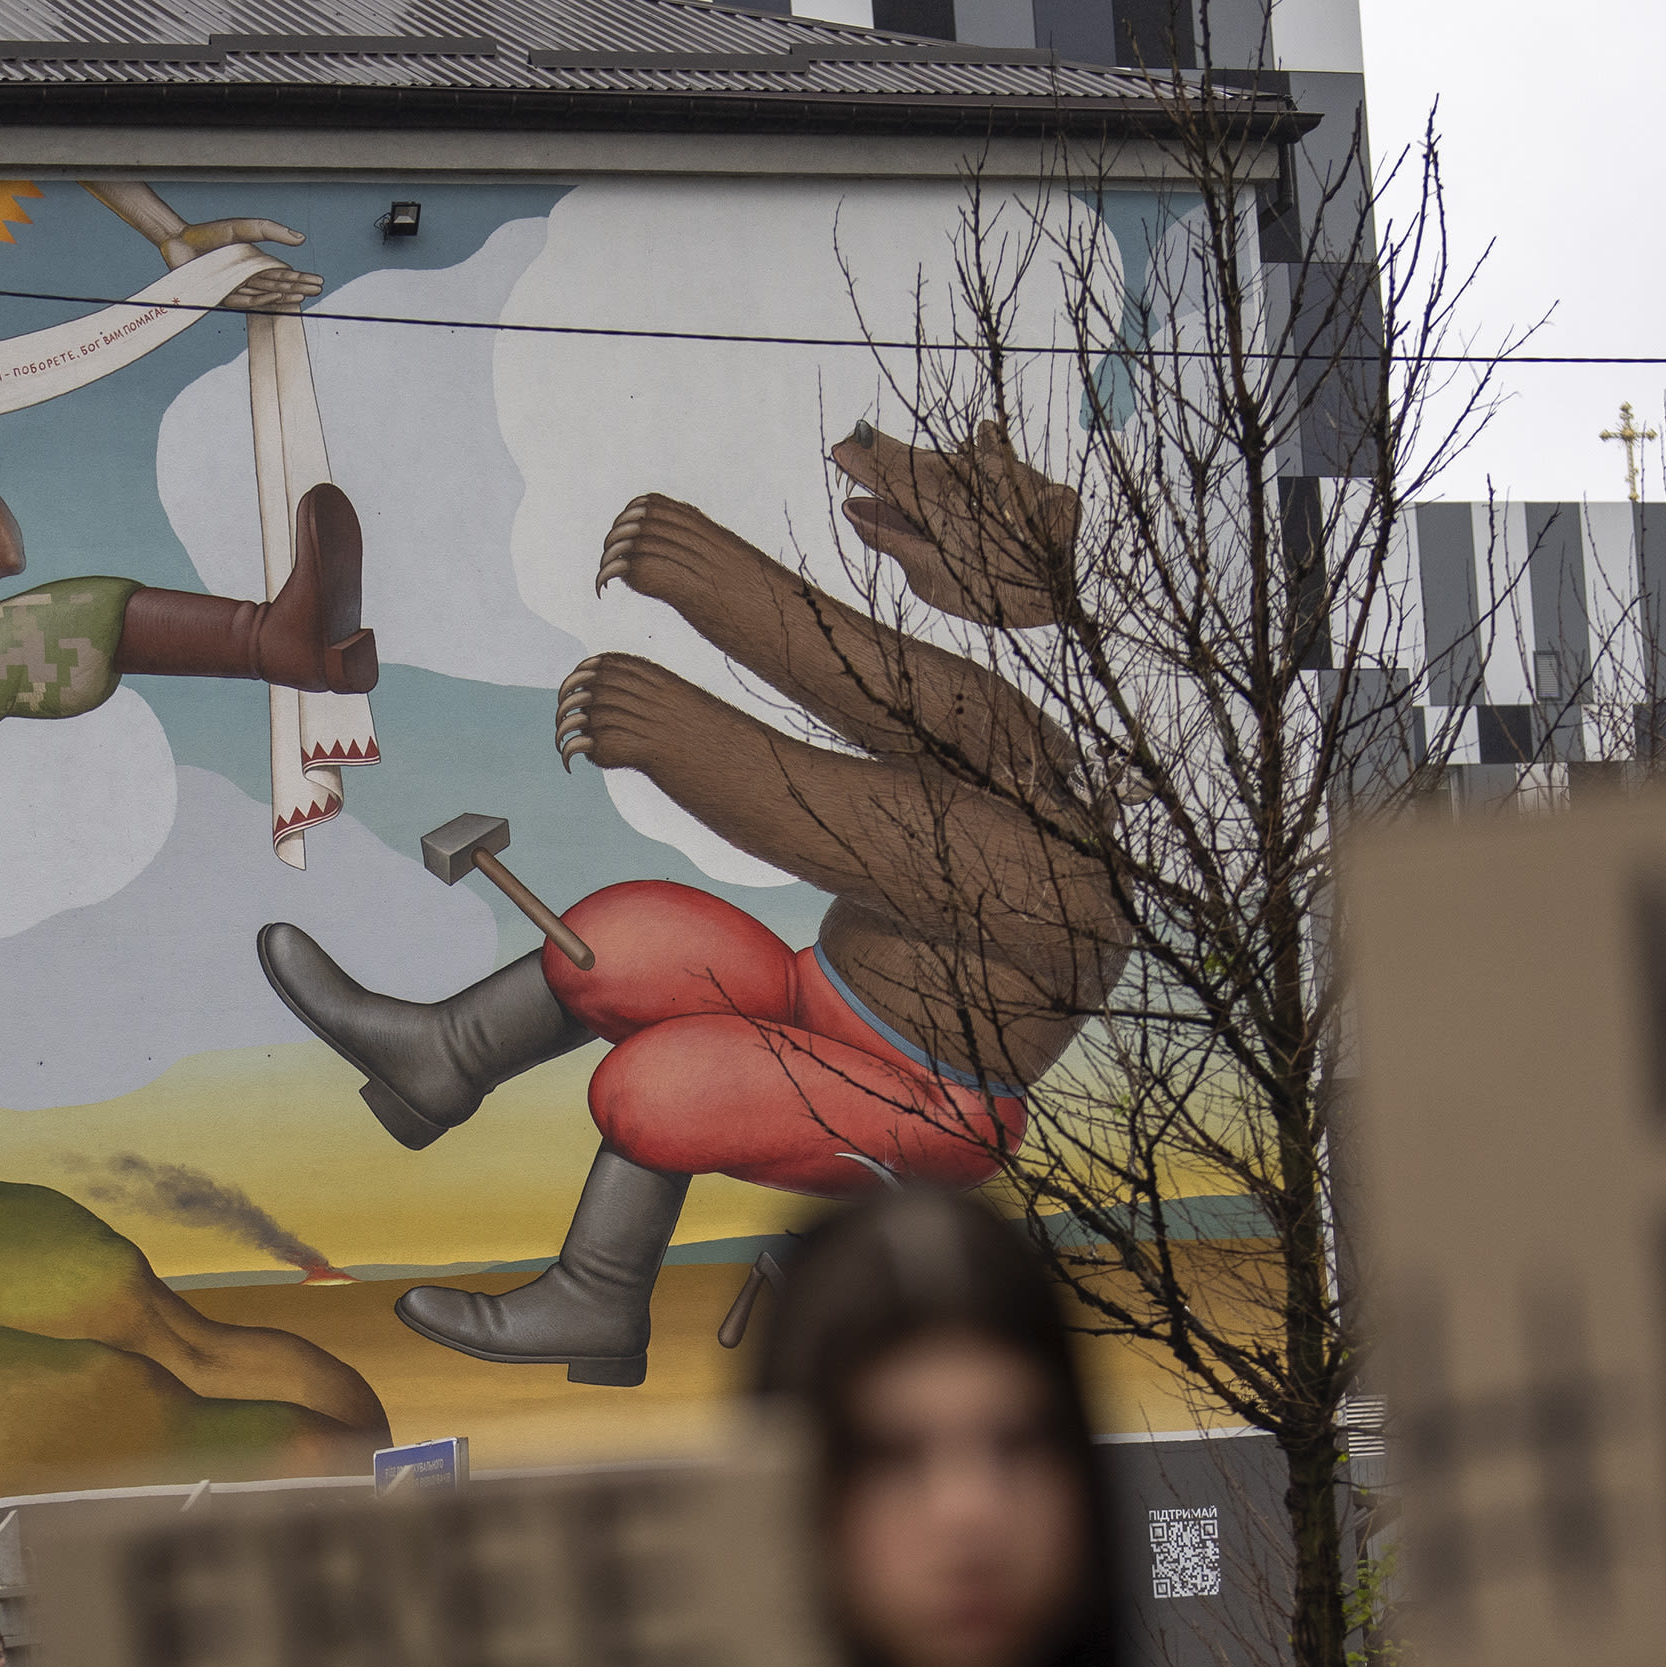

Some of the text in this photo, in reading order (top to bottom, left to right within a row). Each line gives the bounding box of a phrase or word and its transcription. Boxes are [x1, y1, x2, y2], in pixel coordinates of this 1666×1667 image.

[80, 339, 101, 356] БОГ
[103, 329, 123, 345] ВАМ
[122, 307, 169, 335] ПОМАГАЄ
[1148, 1505, 1218, 1522] ПІДТРИМАЙ
